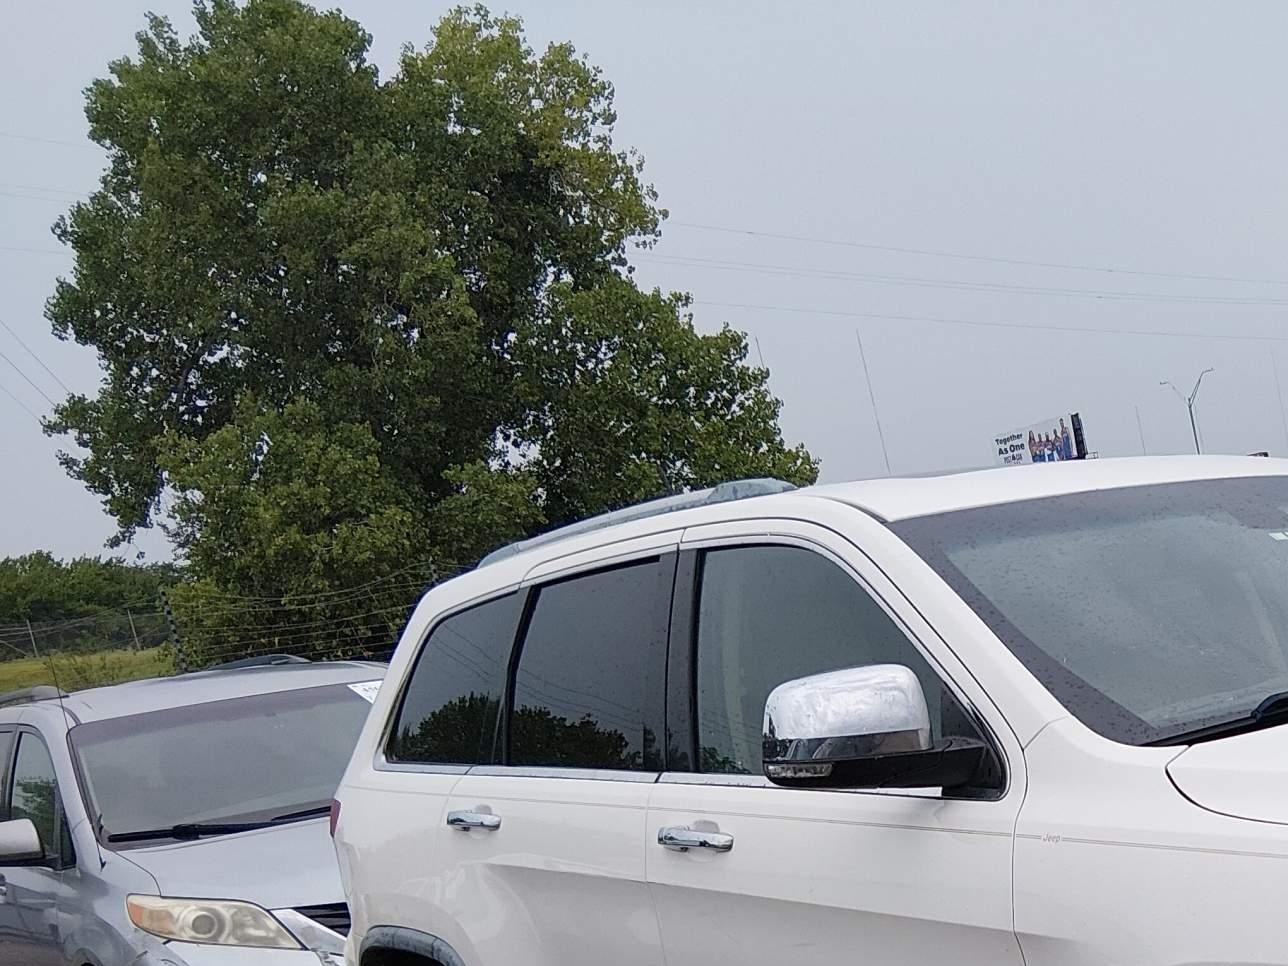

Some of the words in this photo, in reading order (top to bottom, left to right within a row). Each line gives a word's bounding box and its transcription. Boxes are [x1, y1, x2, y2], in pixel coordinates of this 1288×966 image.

[995, 432, 1023, 446] Together
[998, 447, 1009, 456] As
[1009, 443, 1025, 453] One
